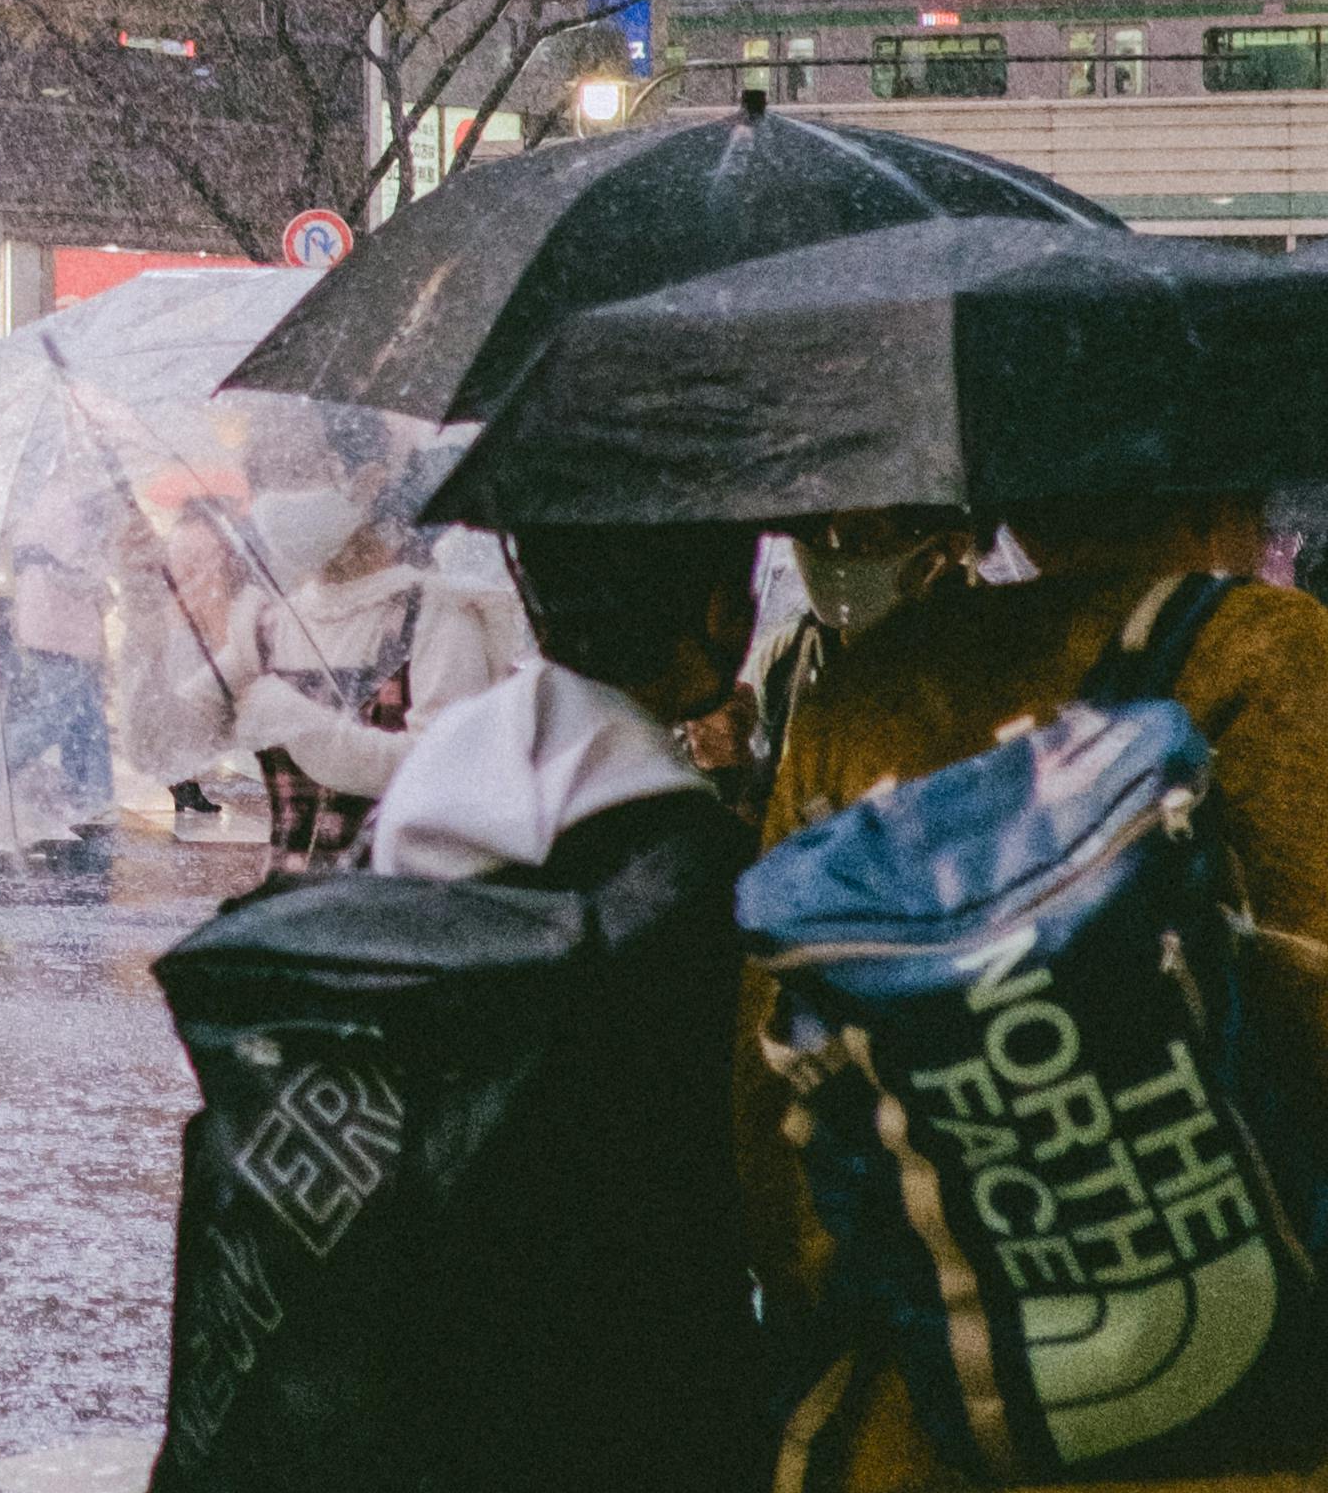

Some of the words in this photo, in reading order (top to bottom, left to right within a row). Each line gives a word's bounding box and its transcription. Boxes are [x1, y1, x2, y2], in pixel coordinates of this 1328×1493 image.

[911, 1054, 1088, 1294] FACE
[954, 924, 1176, 1285] NORTH
[1116, 1039, 1256, 1260] THE
